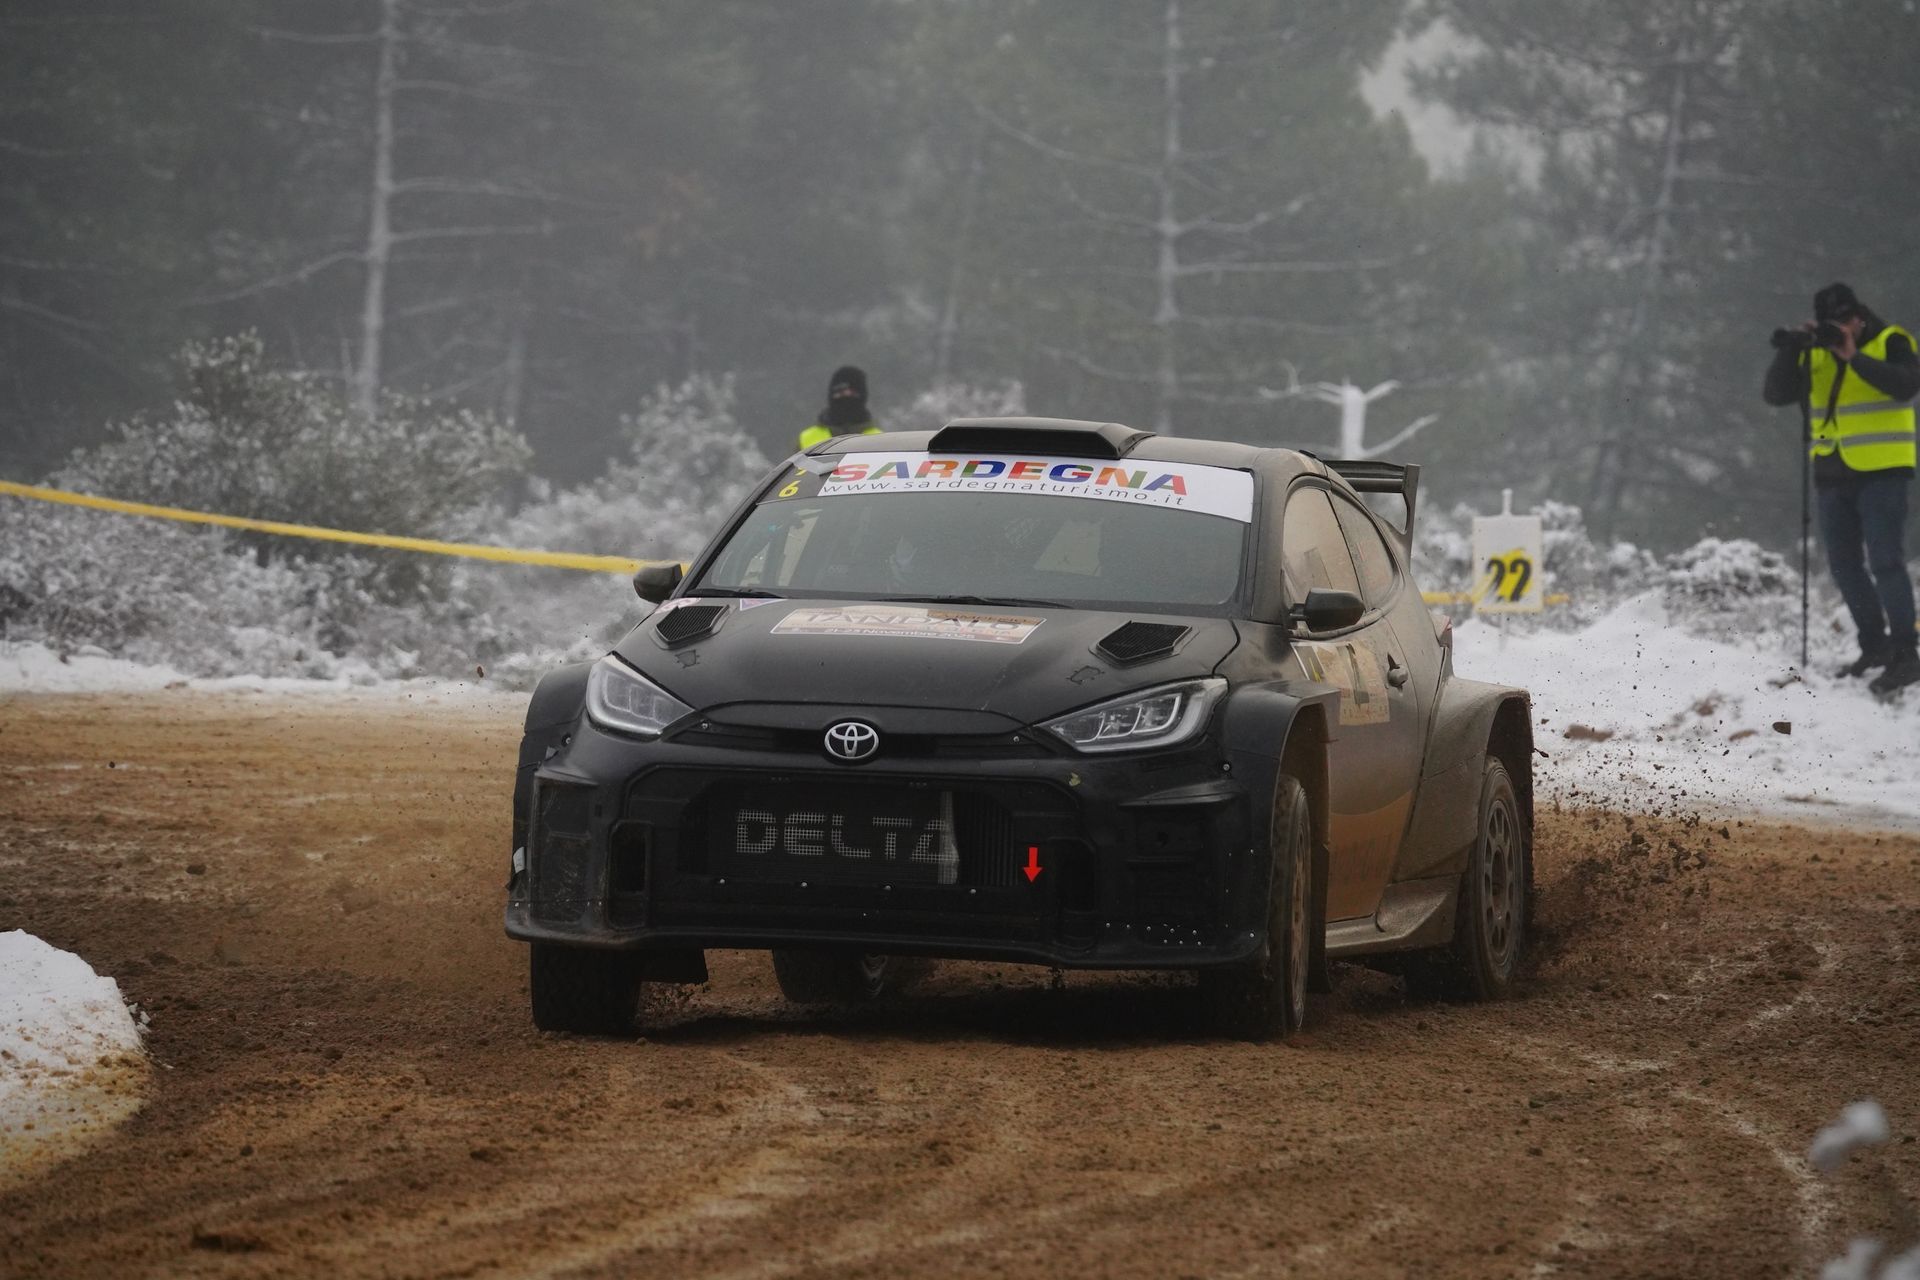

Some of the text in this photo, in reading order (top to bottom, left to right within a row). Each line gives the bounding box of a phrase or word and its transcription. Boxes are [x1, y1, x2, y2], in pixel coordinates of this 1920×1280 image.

[823, 479, 1184, 506] www.sardegnaturismo.it
[829, 460, 1187, 496] SARDEGNA
[736, 808, 960, 864] DELTA
